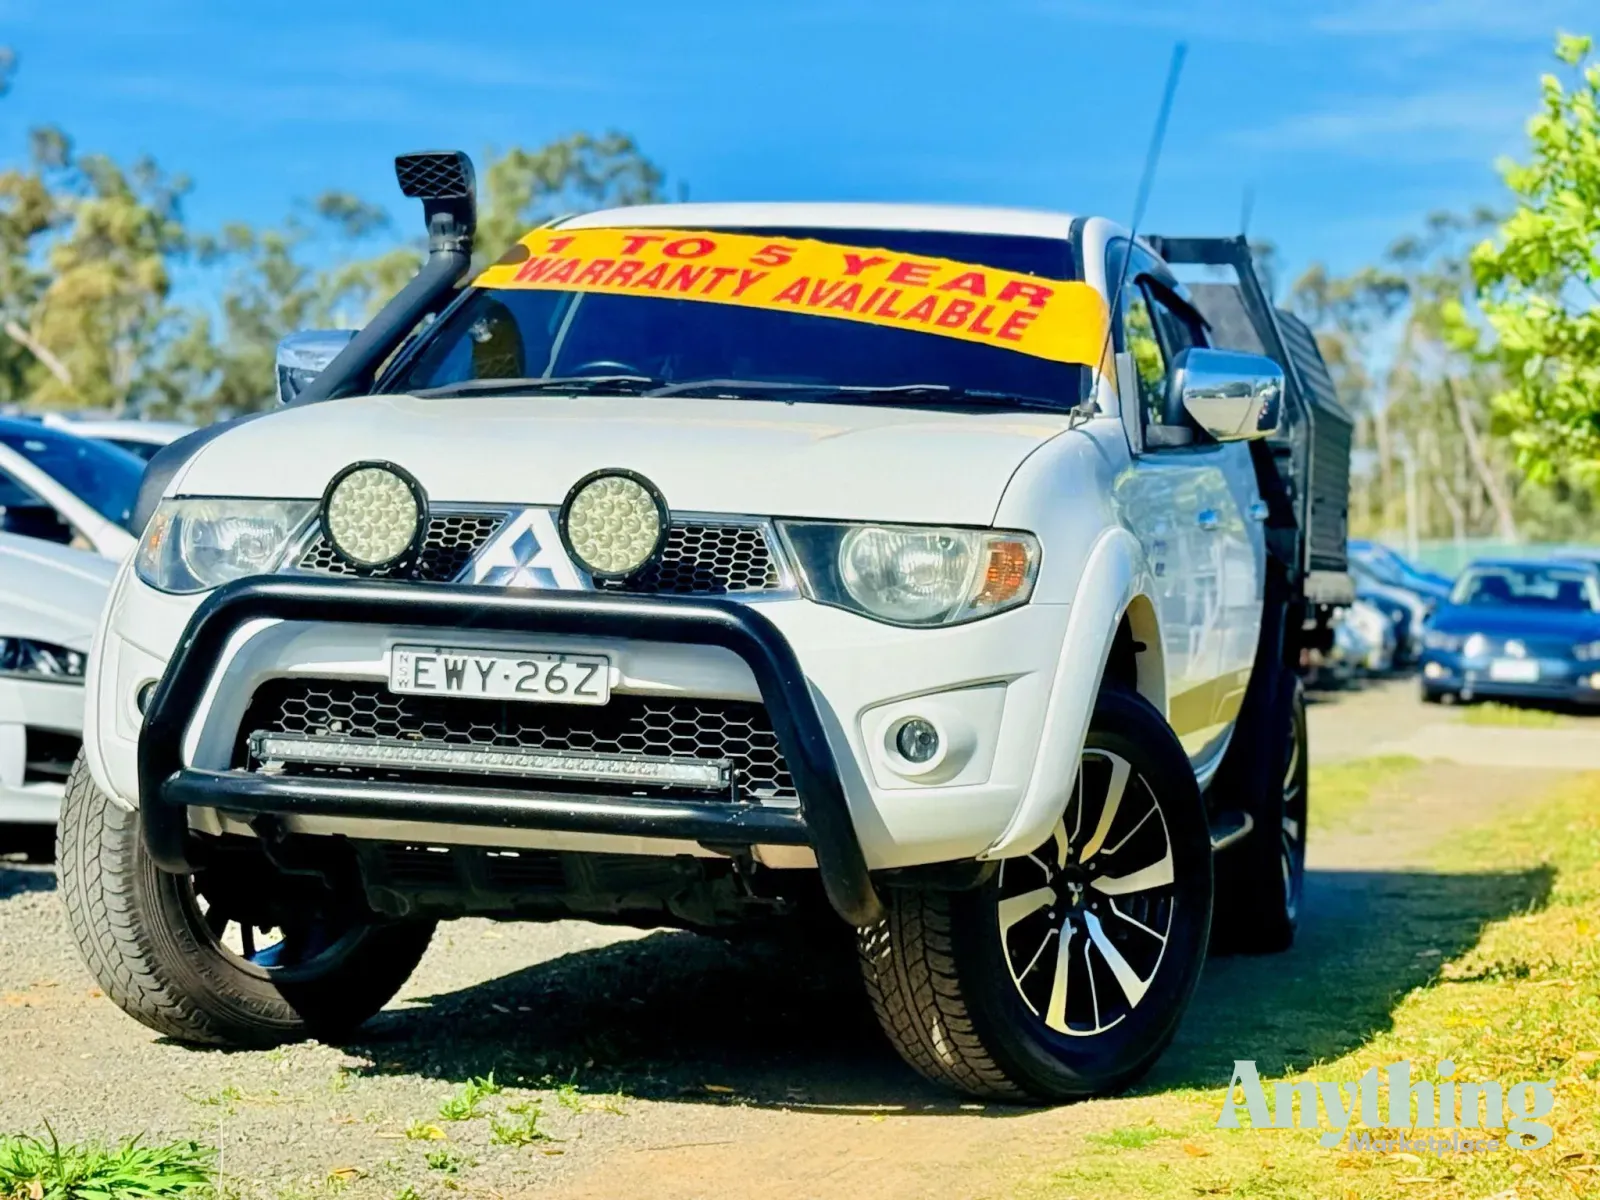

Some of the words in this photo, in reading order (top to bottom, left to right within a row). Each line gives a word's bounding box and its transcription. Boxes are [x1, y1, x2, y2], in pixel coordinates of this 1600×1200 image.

[513, 257, 771, 297] WARRANTY
[771, 276, 1039, 341] AVAILABLE
[547, 236, 577, 254] 1
[620, 235, 717, 260] TO
[748, 244, 798, 267] 5
[842, 253, 1054, 308] YEAR
